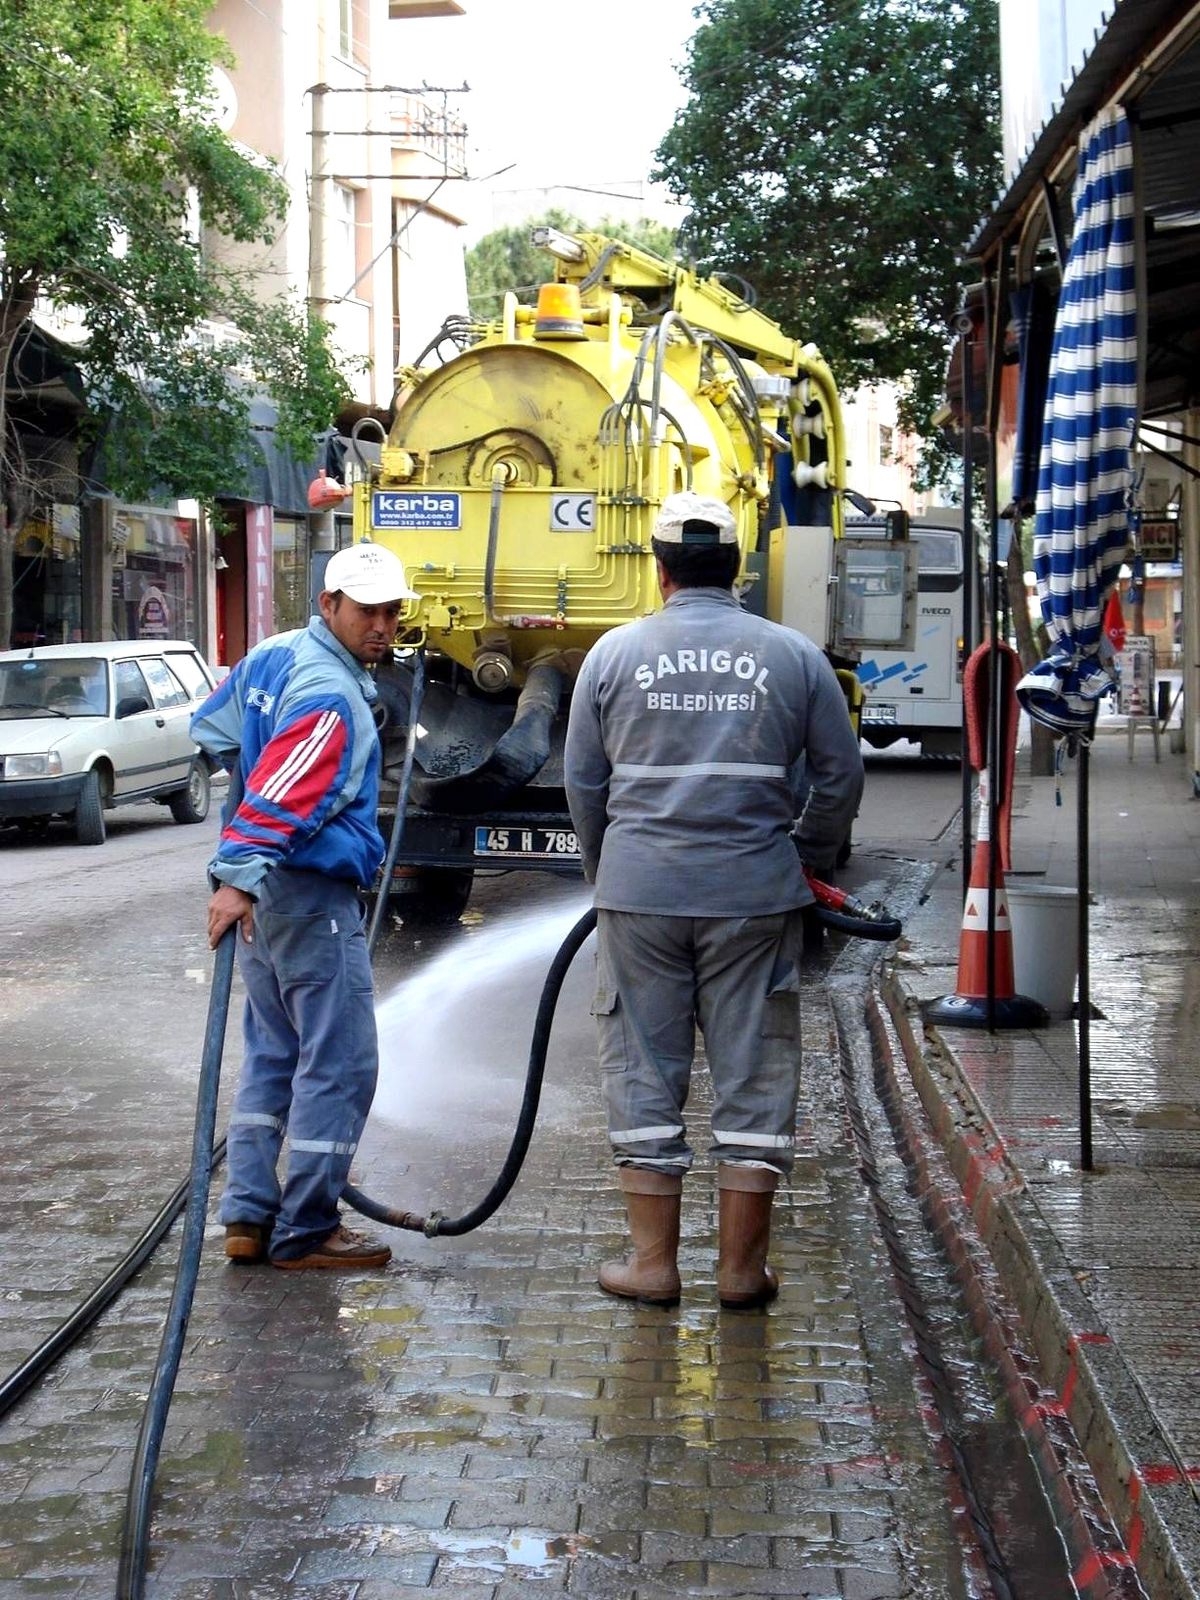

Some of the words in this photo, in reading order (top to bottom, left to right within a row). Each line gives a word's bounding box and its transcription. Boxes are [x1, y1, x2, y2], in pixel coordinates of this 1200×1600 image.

[379, 495, 455, 511] karba
[554, 499, 592, 526] CE
[634, 649, 769, 695] SARIGÖL
[647, 691, 757, 711] BELEDİYESİ
[487, 830, 509, 851] 45
[521, 831, 533, 852] H
[544, 832, 581, 853] 789
